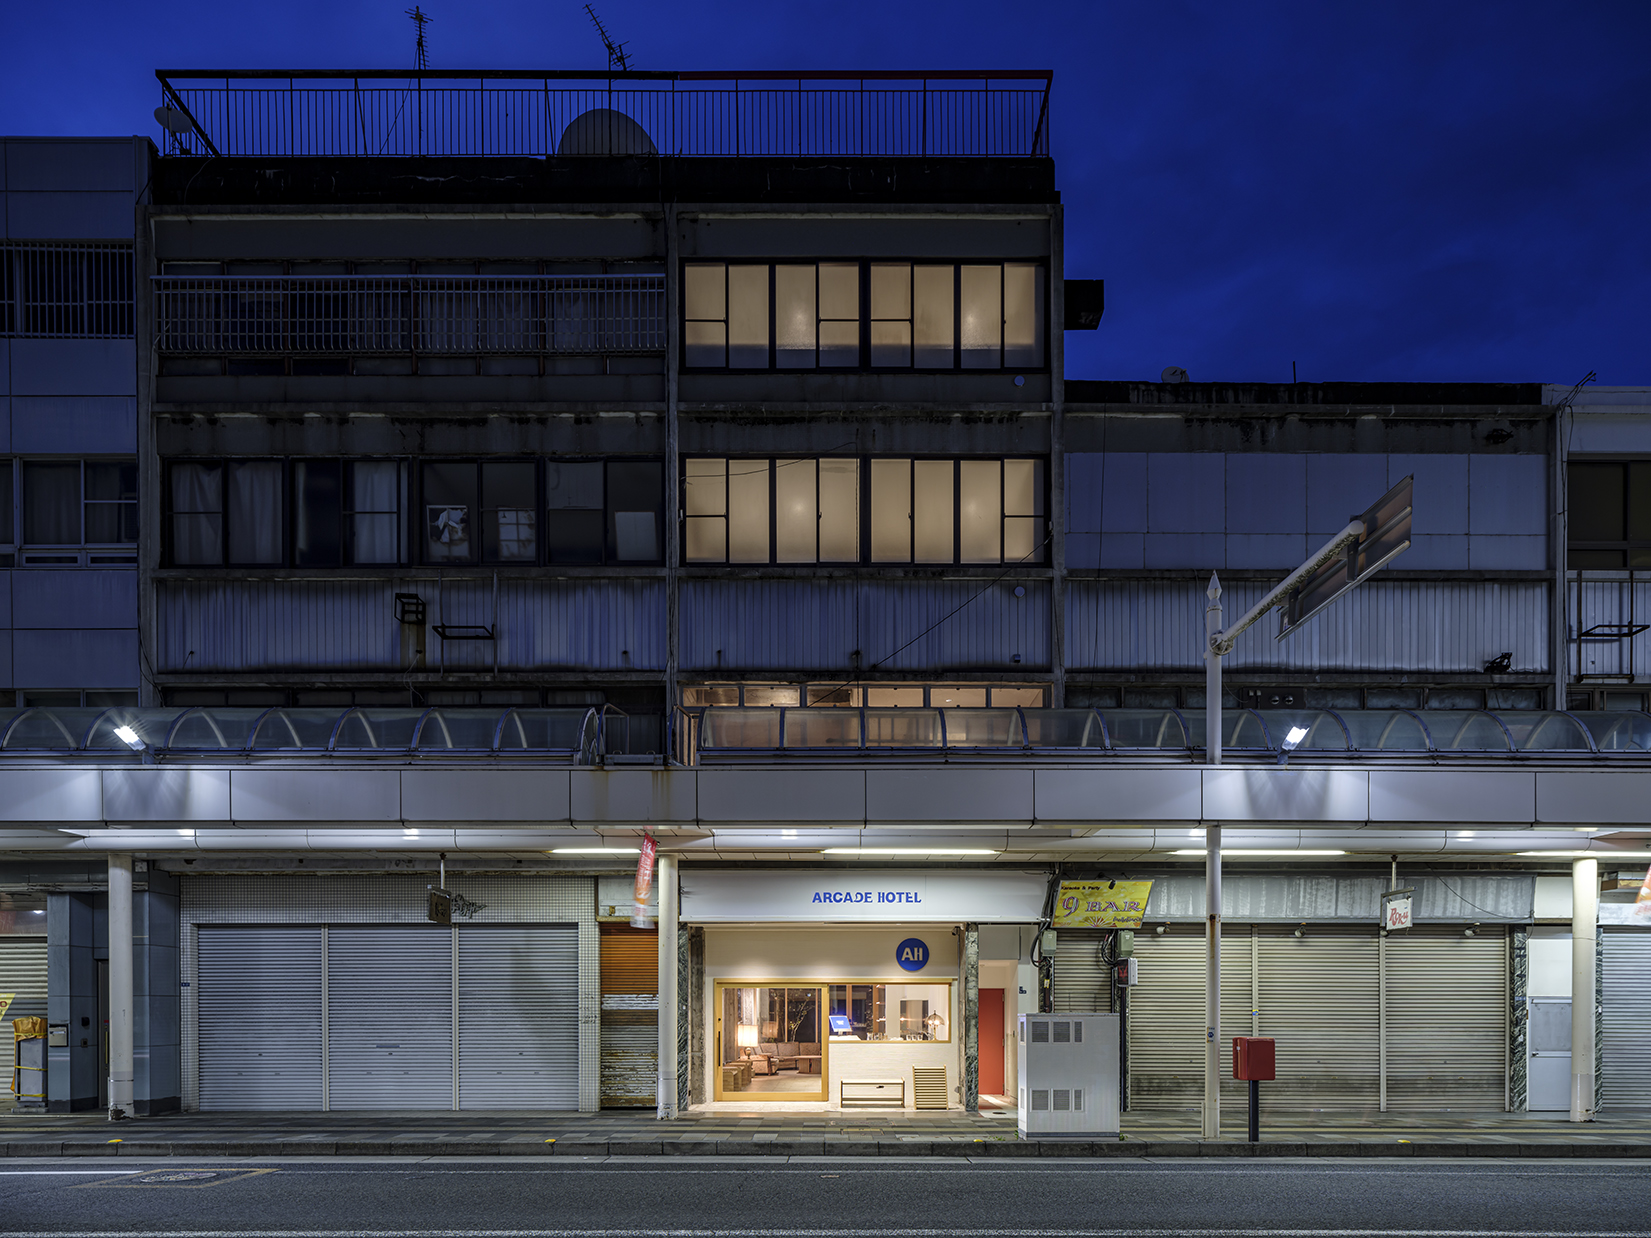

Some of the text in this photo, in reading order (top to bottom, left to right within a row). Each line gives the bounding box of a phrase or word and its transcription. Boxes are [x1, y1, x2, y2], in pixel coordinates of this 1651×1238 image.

[812, 891, 922, 903] ARCADE HOTEL
[1062, 896, 1144, 917] 9 BAR
[901, 947, 923, 961] AH
